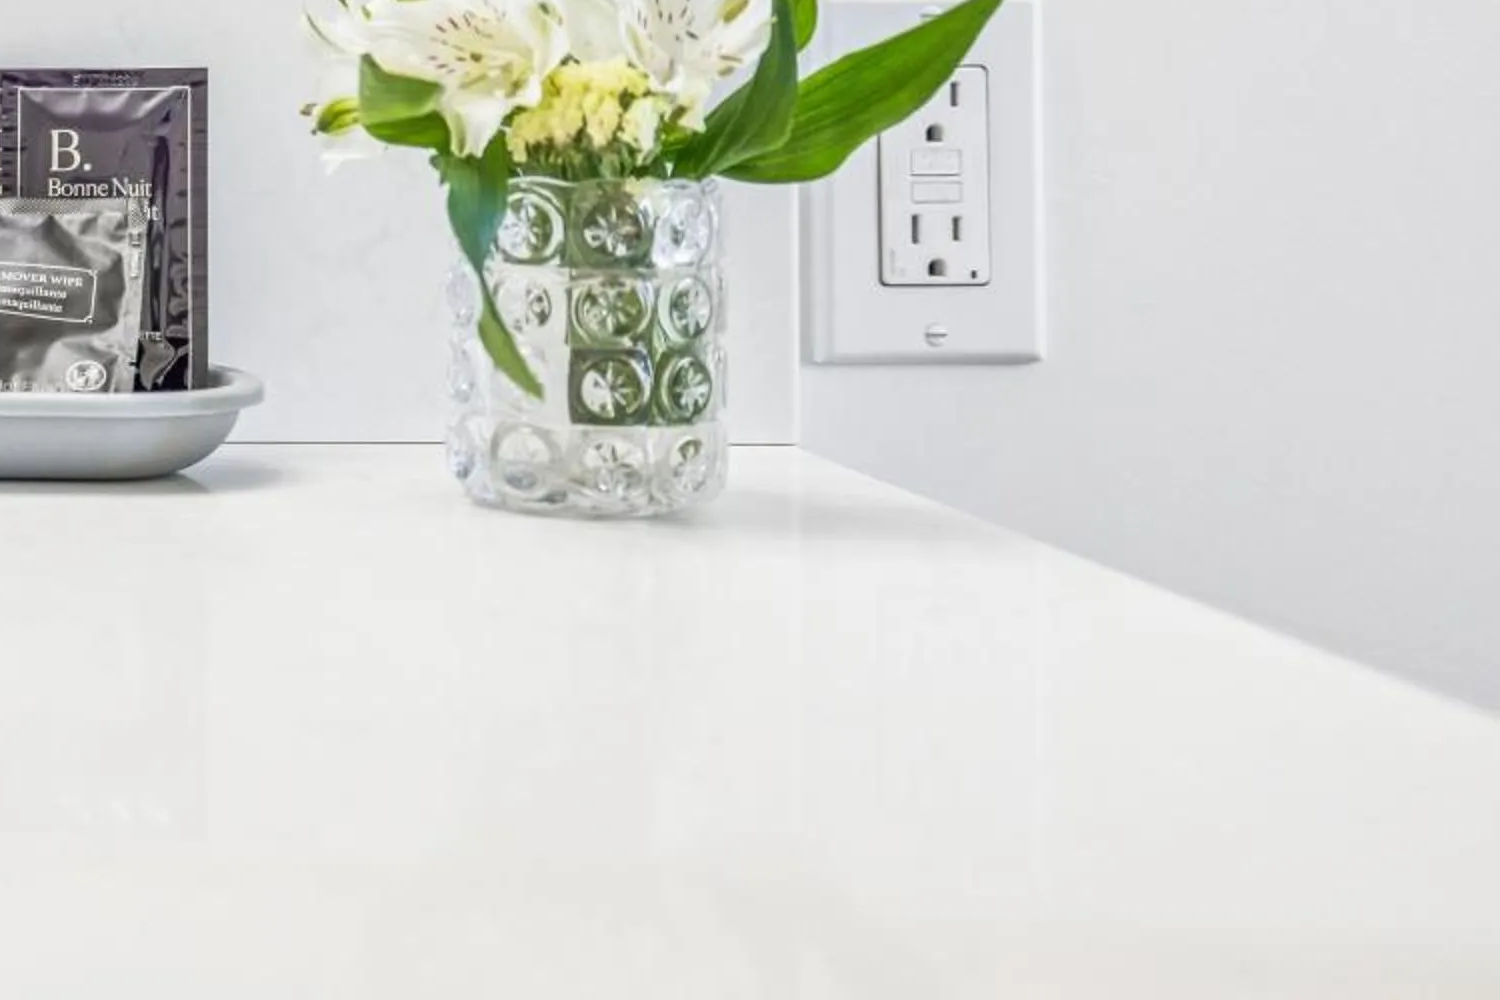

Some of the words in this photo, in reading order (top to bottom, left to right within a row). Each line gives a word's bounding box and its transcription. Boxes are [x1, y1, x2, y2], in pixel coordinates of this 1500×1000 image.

[49, 129, 93, 172] B.
[47, 178, 109, 197] Bonne
[112, 177, 152, 198] Nuit
[51, 276, 84, 287] WIPE
